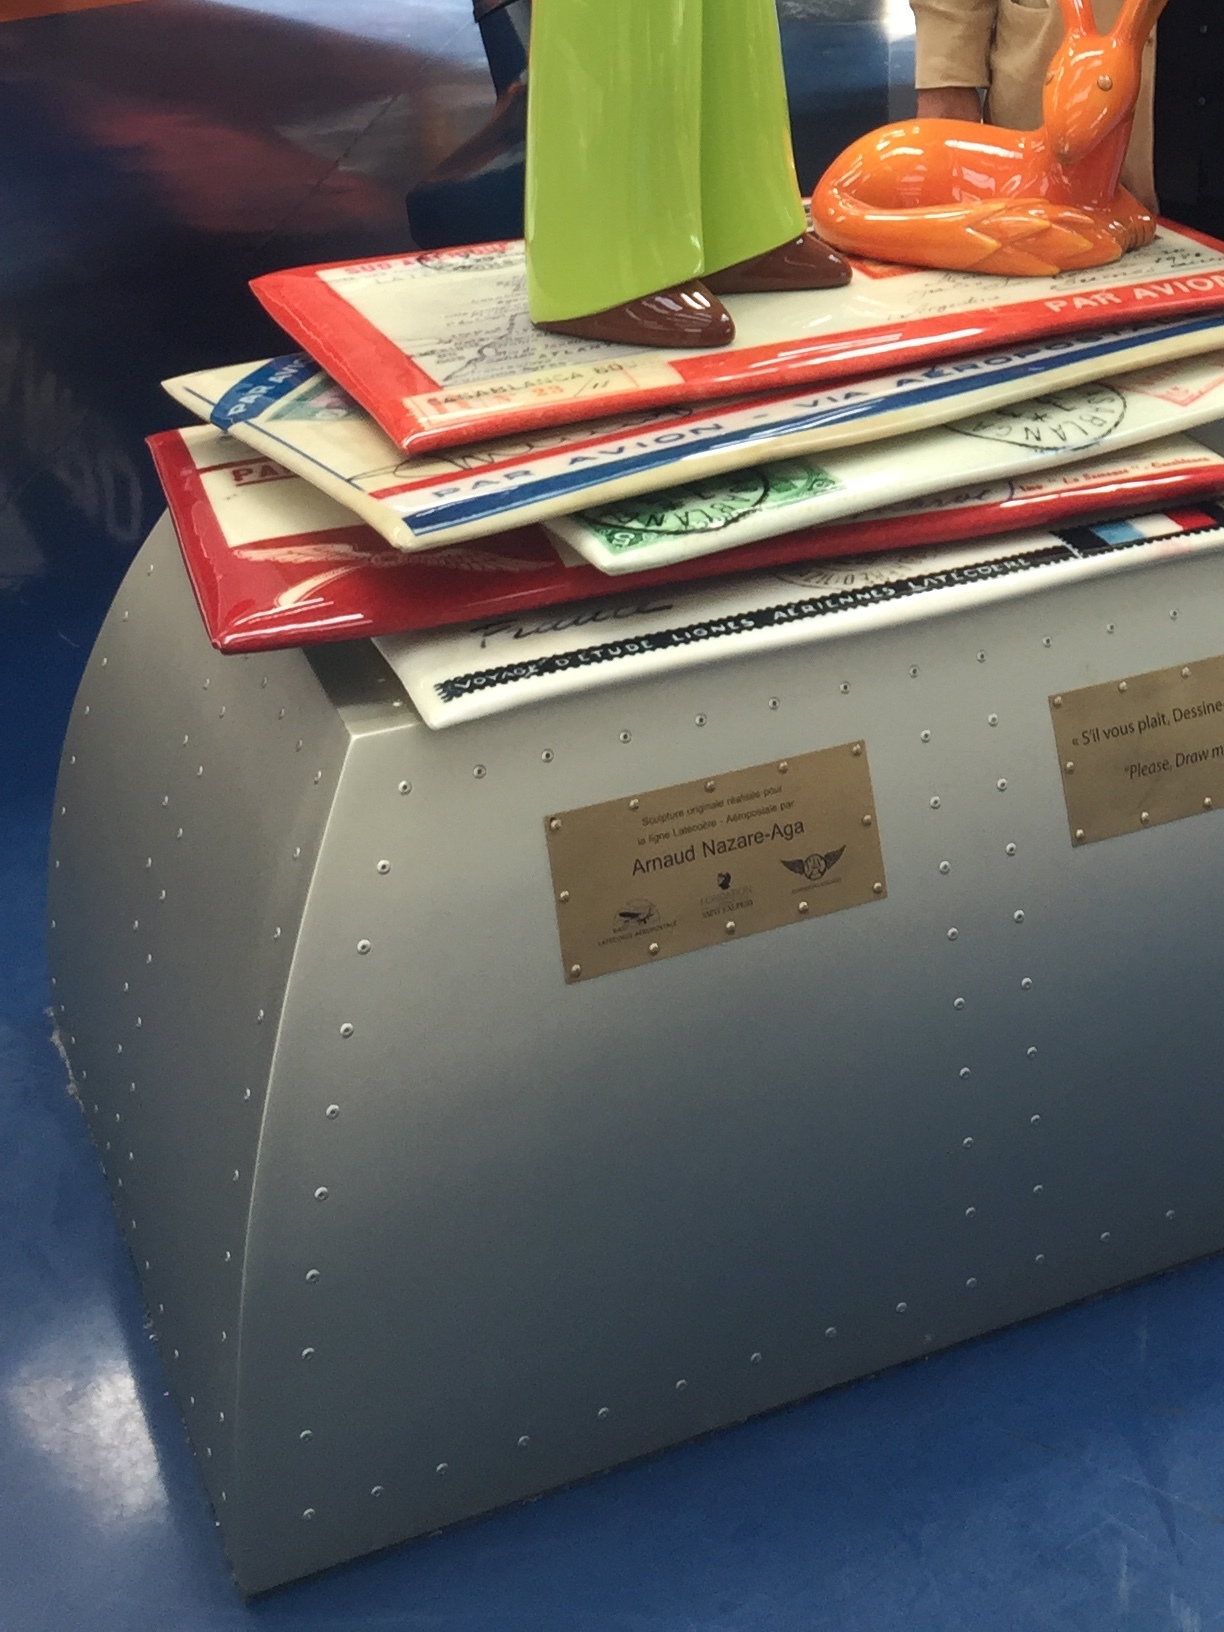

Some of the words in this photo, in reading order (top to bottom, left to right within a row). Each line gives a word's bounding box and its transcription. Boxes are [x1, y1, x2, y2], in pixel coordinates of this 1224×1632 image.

[1045, 290, 1122, 313] PAR
[227, 384, 275, 417] PAR
[432, 470, 535, 499] PAR
[569, 422, 725, 466] AVION
[796, 390, 867, 408] VIA
[671, 617, 755, 642] LIGNES
[1081, 727, 1100, 746] S'il
[1103, 721, 1135, 740] vous
[1175, 749, 1208, 768] Draw
[632, 845, 695, 876] Arnaud
[702, 820, 804, 858] Nazare-Aga
[649, 831, 670, 845] ligne
